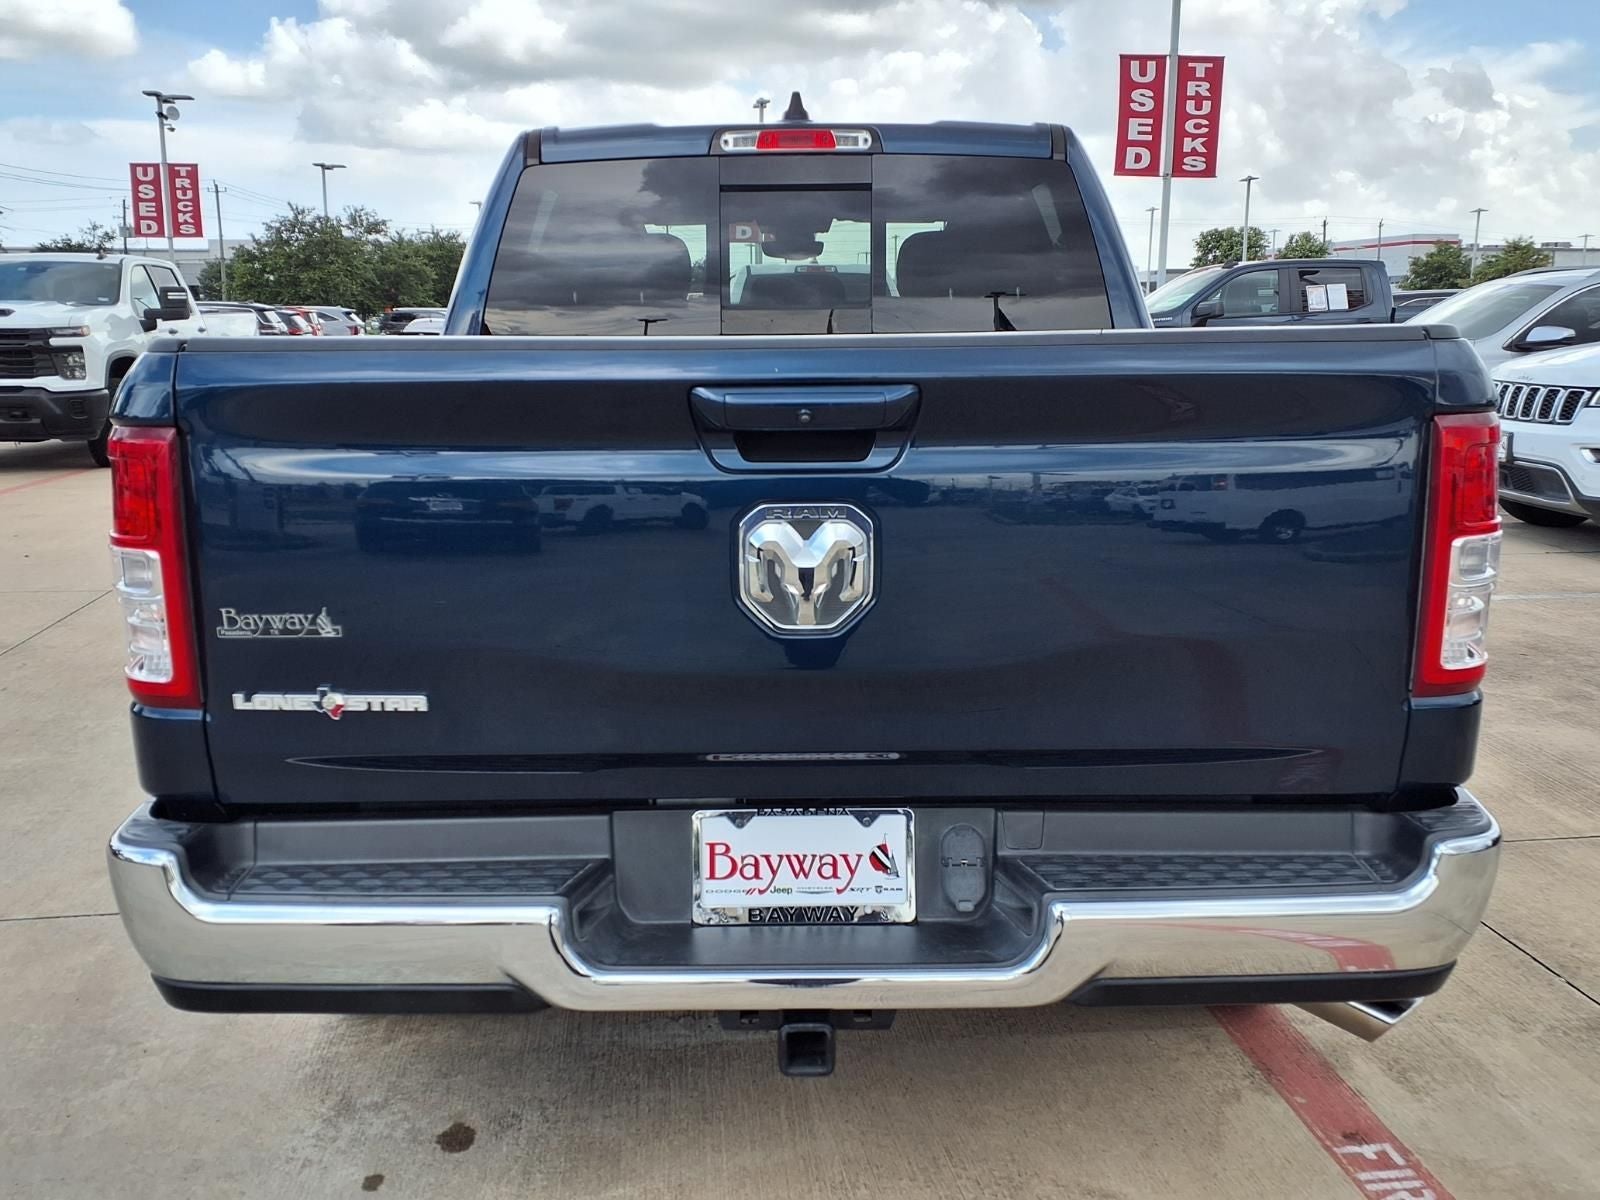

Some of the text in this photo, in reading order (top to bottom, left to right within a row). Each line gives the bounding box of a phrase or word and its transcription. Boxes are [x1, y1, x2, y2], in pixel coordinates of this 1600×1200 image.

[1124, 60, 1214, 171] USED TRUCKS
[136, 166, 197, 234] USED TRUCKS
[765, 507, 847, 519] RAM
[218, 607, 314, 637] Bayway
[232, 693, 429, 712] LONE STAR
[704, 841, 864, 896] Bayway
[769, 885, 793, 895] Jeep
[748, 905, 860, 923] BAYWAY
